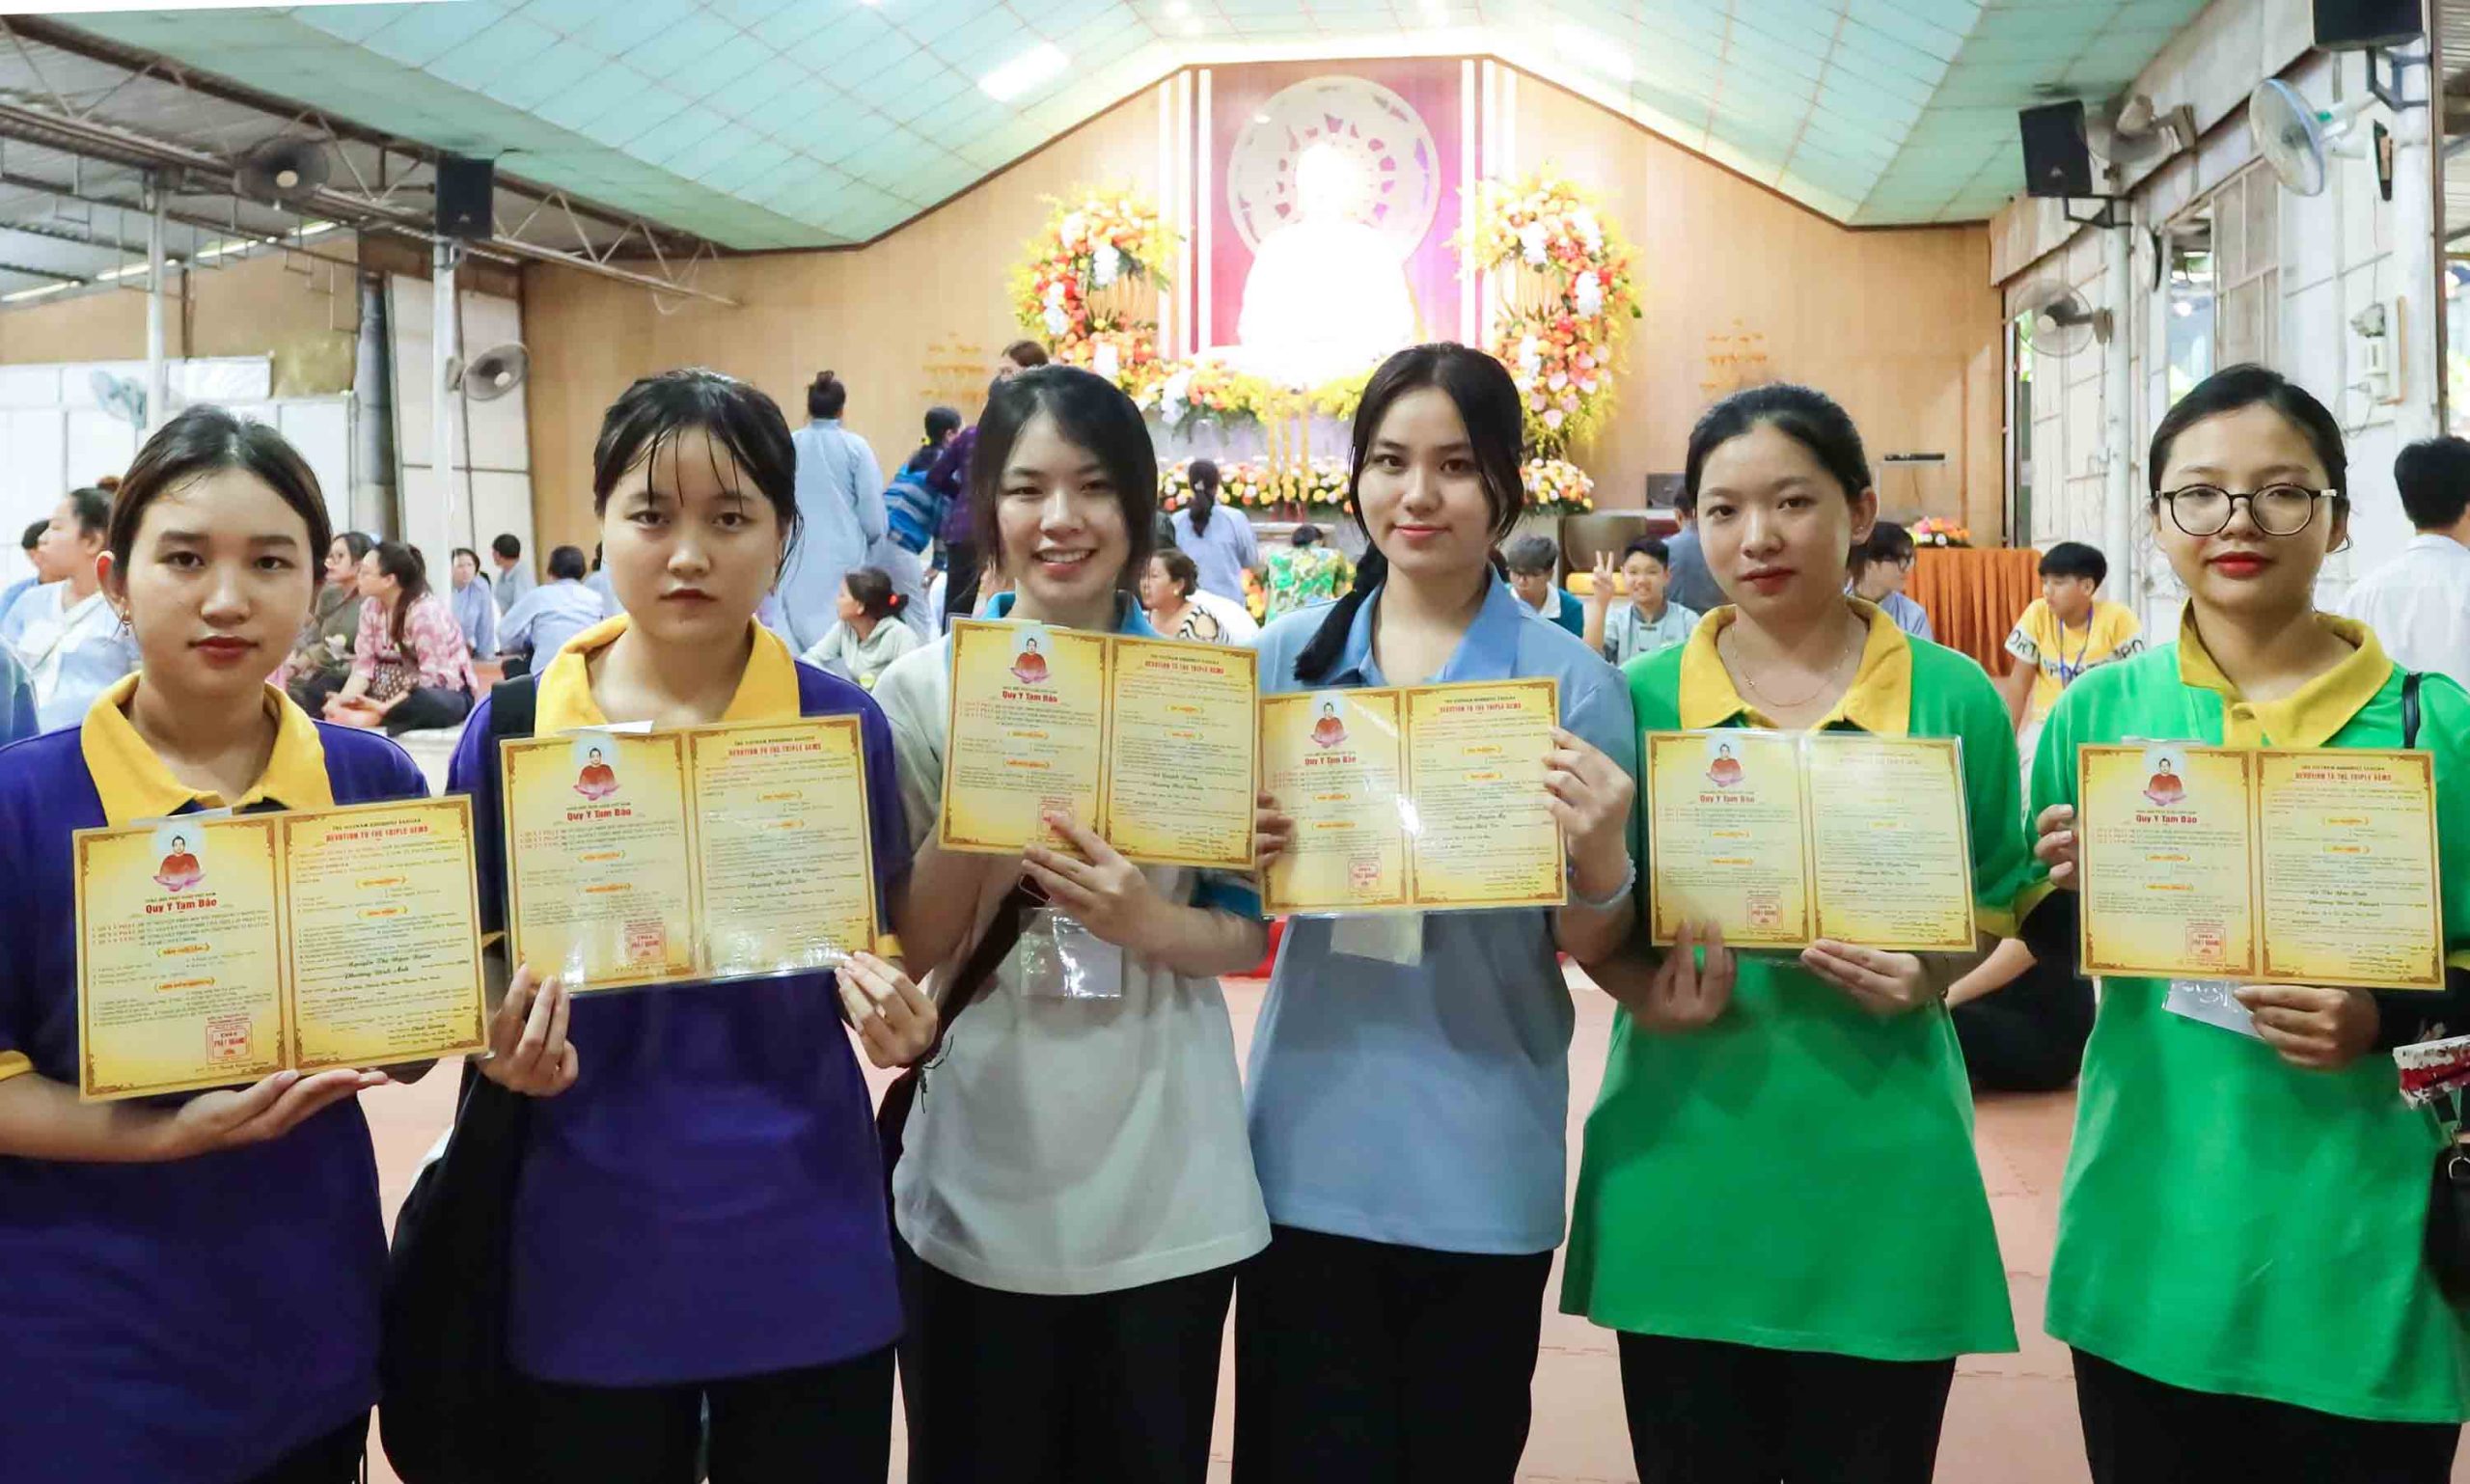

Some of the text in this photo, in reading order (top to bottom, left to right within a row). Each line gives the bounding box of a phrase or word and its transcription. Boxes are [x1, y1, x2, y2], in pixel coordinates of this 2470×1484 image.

[2135, 813, 2152, 824] Quy
[2154, 814, 2159, 823] Y
[146, 904, 164, 915] Quy
[167, 902, 173, 912] Y
[177, 900, 196, 911] Tam
